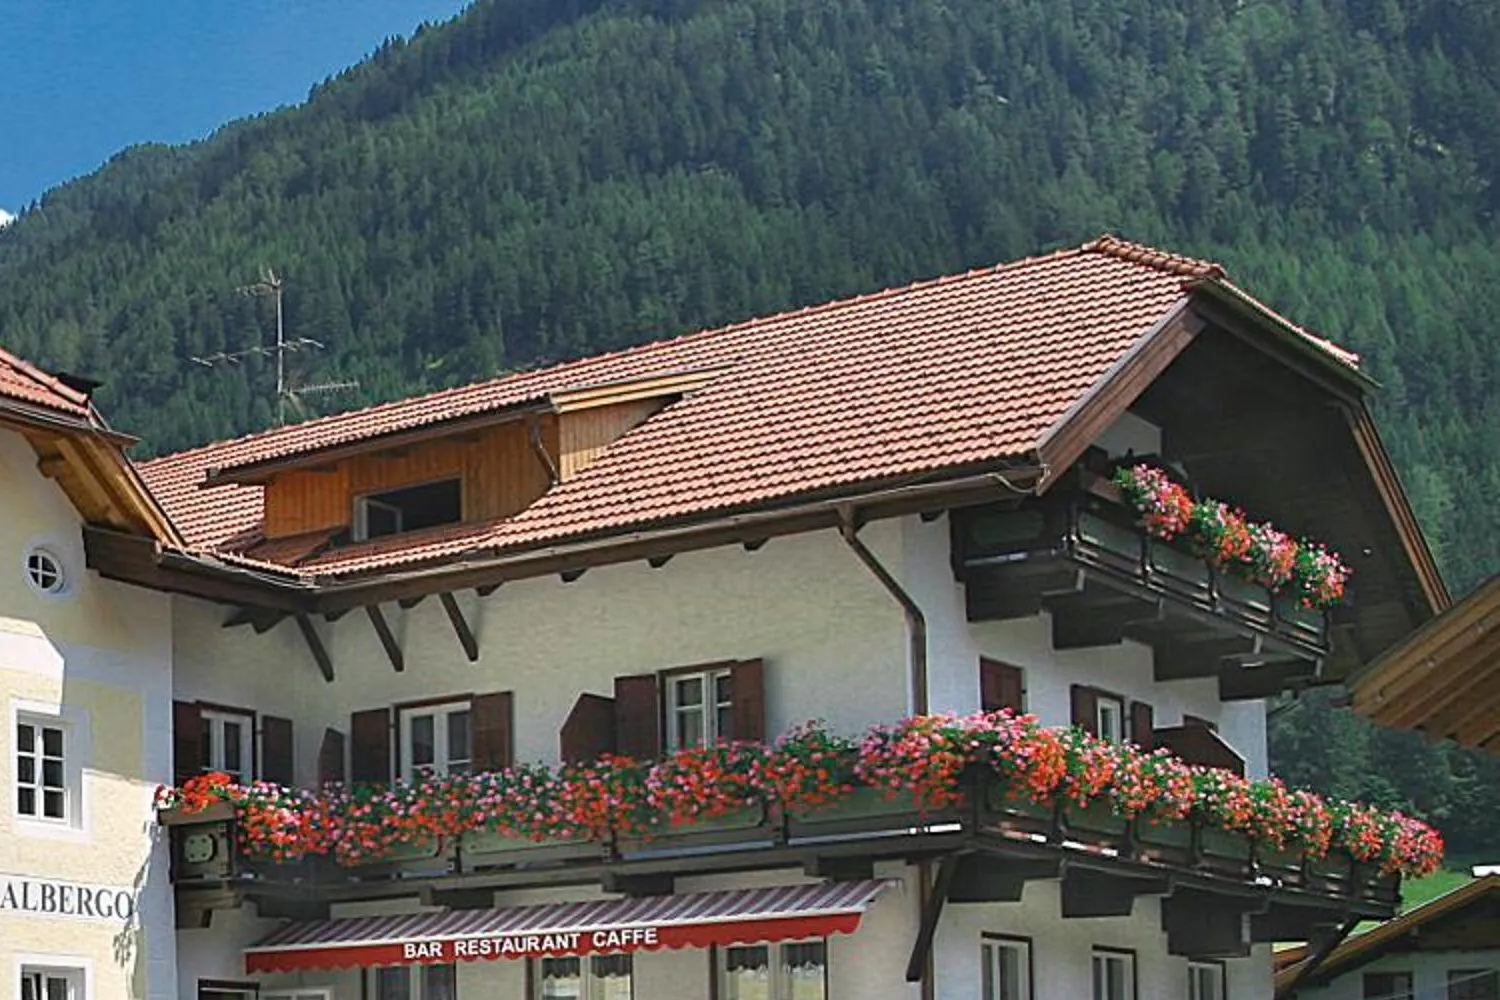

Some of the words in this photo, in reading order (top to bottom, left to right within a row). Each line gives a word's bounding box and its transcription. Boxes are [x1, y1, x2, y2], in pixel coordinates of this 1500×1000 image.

[0, 881, 134, 920] ALBERGO
[403, 943, 443, 959] BAR
[454, 933, 580, 957] RESTAURANT
[592, 927, 657, 948] CAFFE
